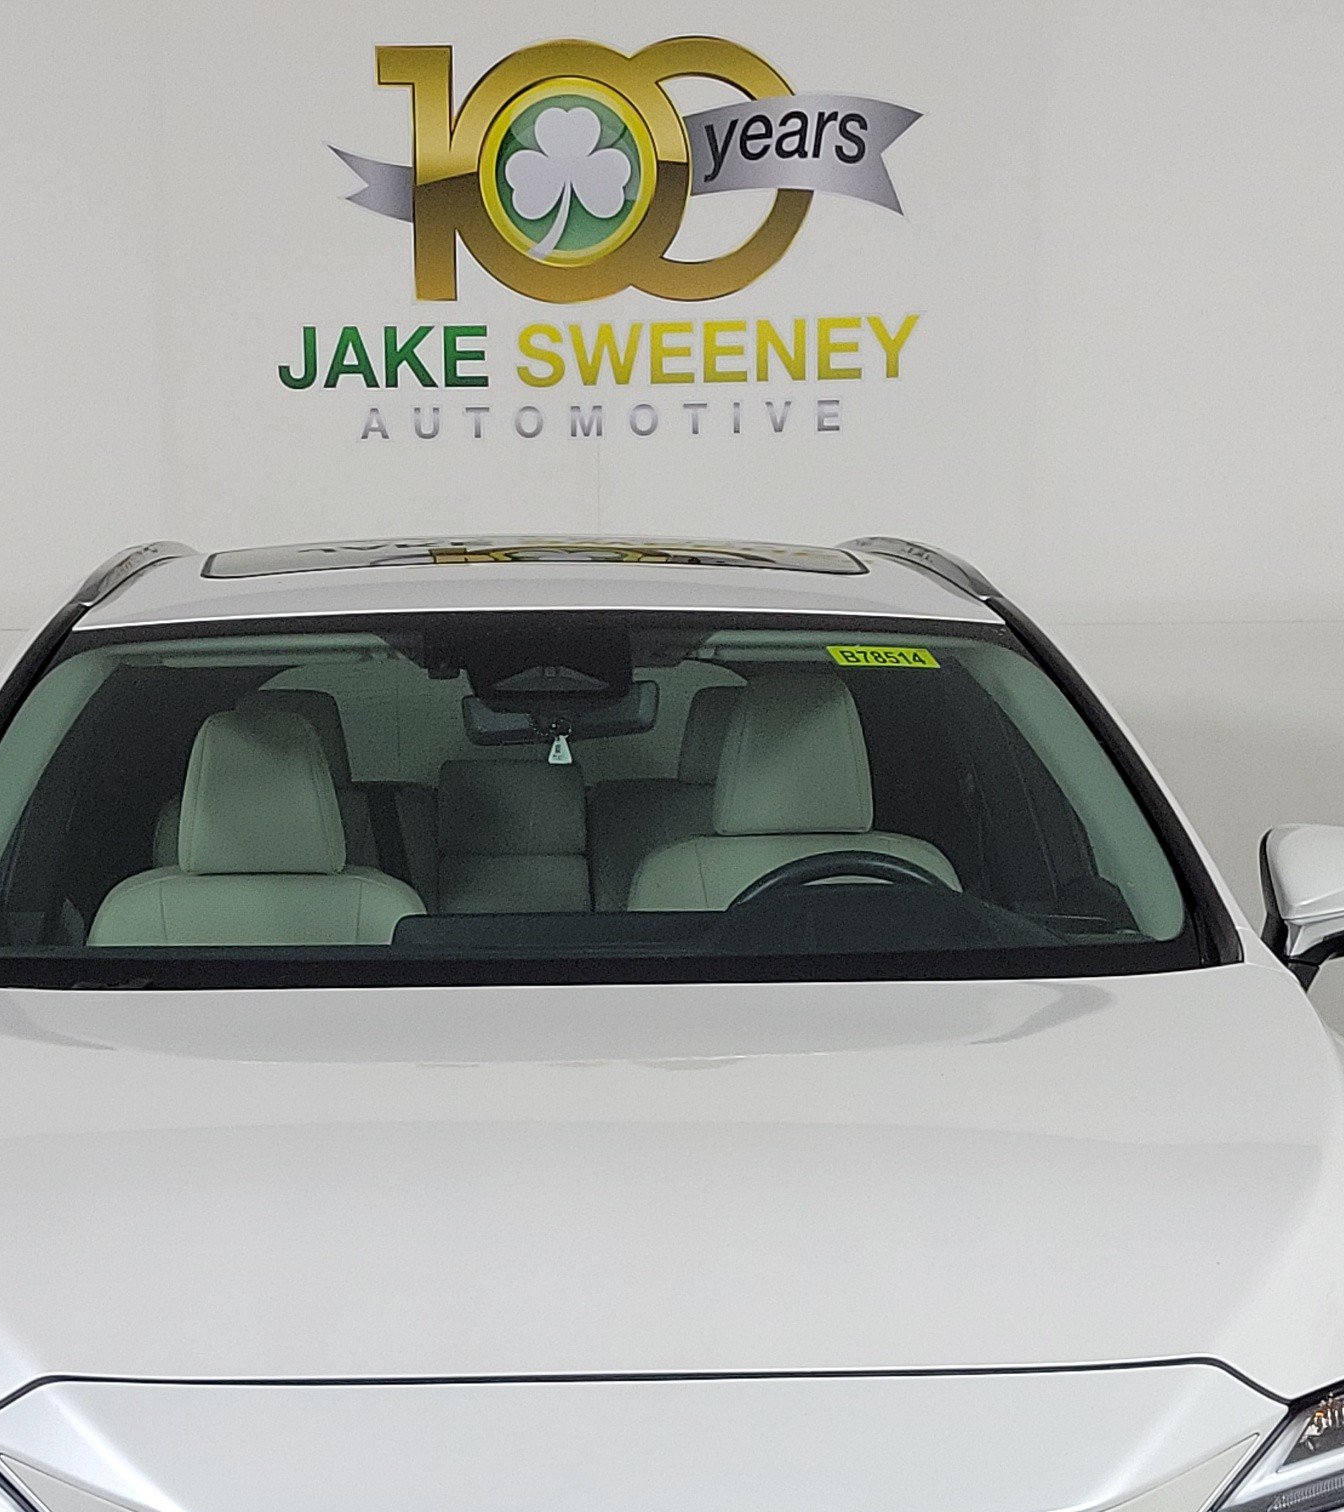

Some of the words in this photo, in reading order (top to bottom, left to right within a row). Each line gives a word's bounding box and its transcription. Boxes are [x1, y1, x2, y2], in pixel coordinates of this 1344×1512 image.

[703, 108, 870, 182] years
[278, 325, 490, 390] JAKE
[515, 314, 920, 389] SWEENEY
[361, 399, 842, 440] AUTOMOTIVE
[839, 650, 926, 665] B78514
